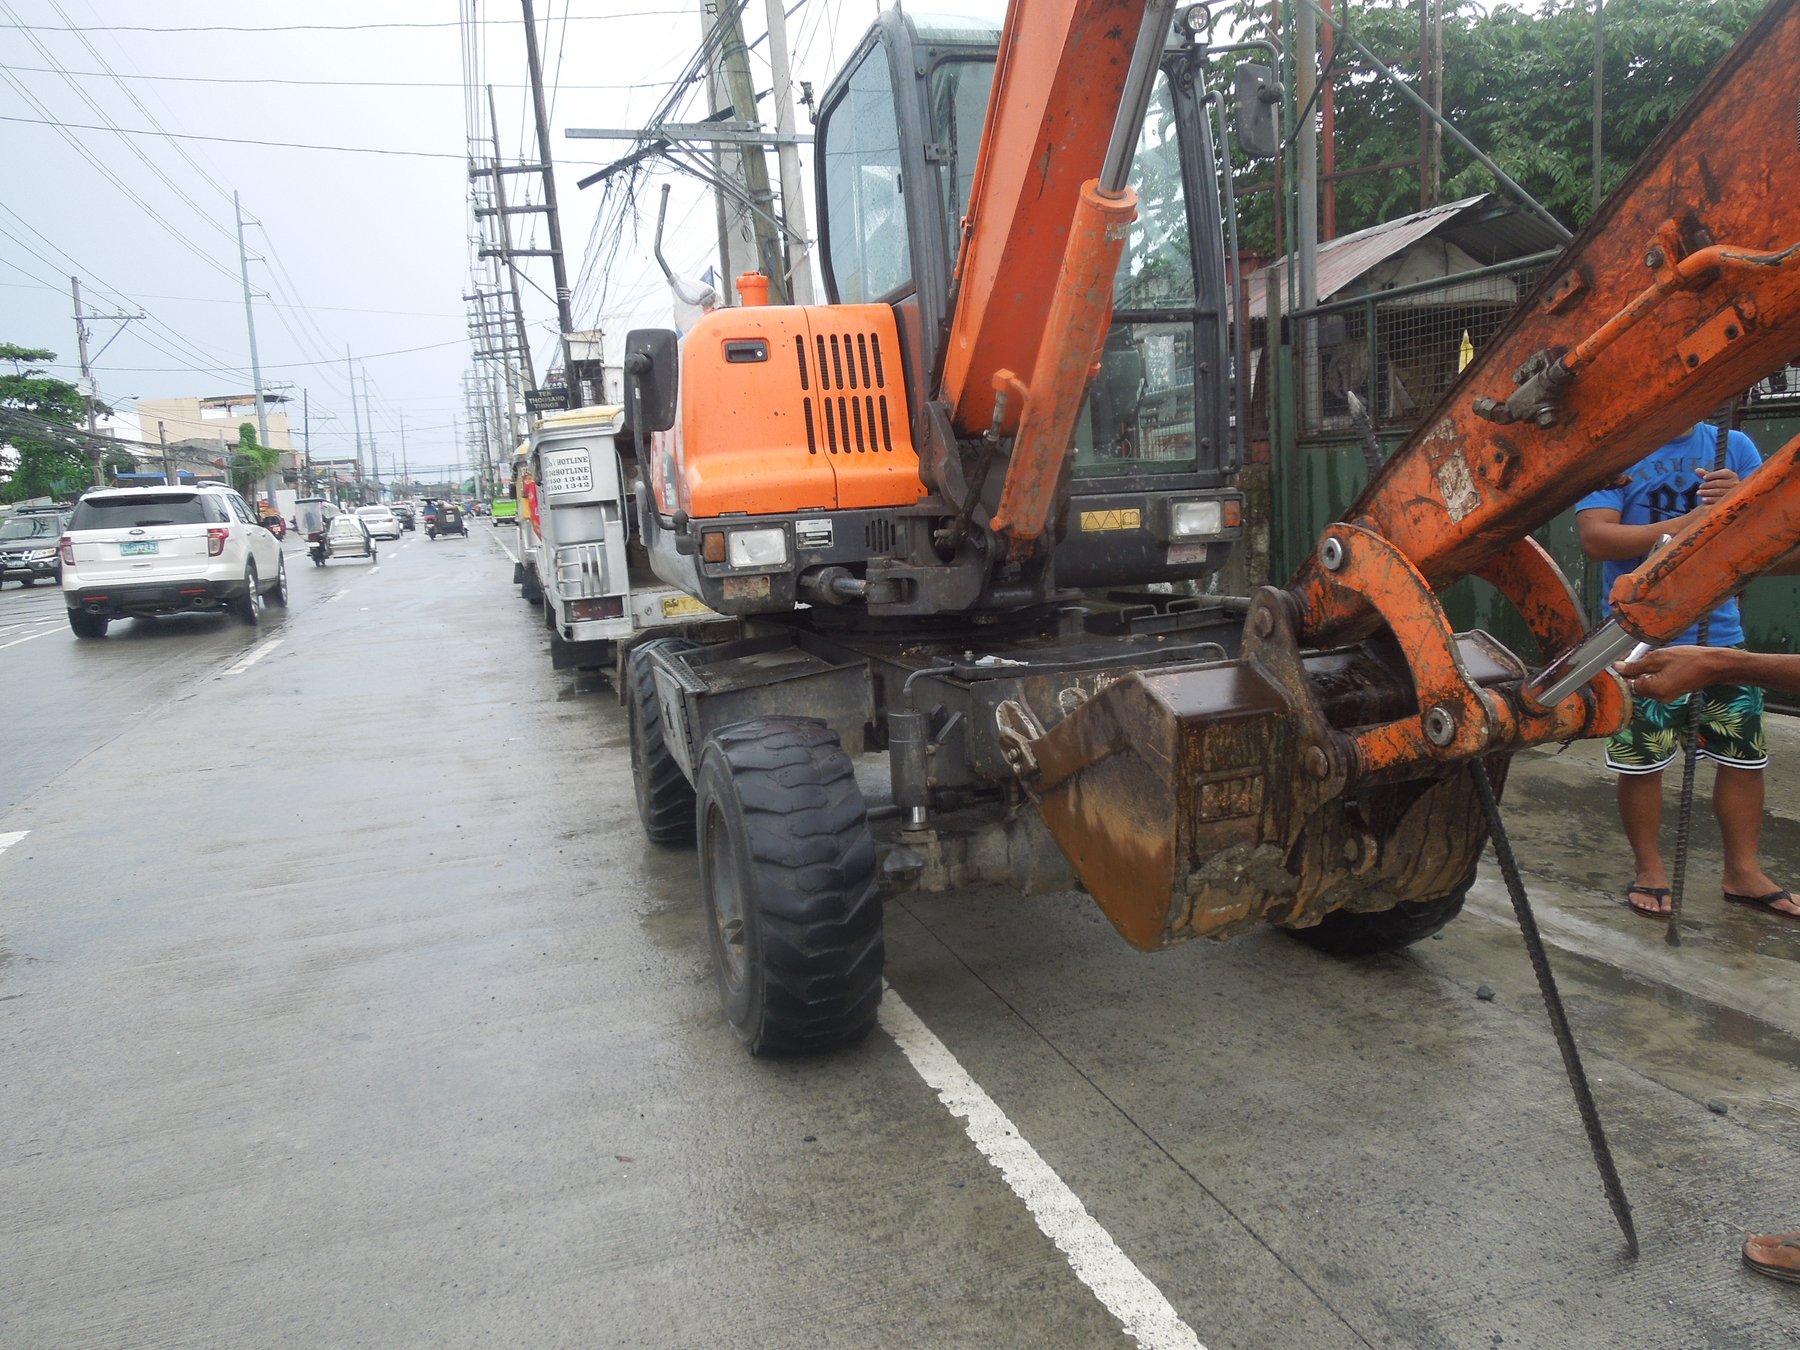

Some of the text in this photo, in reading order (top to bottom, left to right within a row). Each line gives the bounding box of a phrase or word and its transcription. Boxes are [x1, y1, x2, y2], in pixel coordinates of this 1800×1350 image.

[528, 396, 566, 404] THOUSAND
[557, 456, 588, 466] HOTLINE
[556, 466, 590, 476] HOTLINE
[564, 474, 589, 483] 1342
[566, 481, 590, 490] 1342
